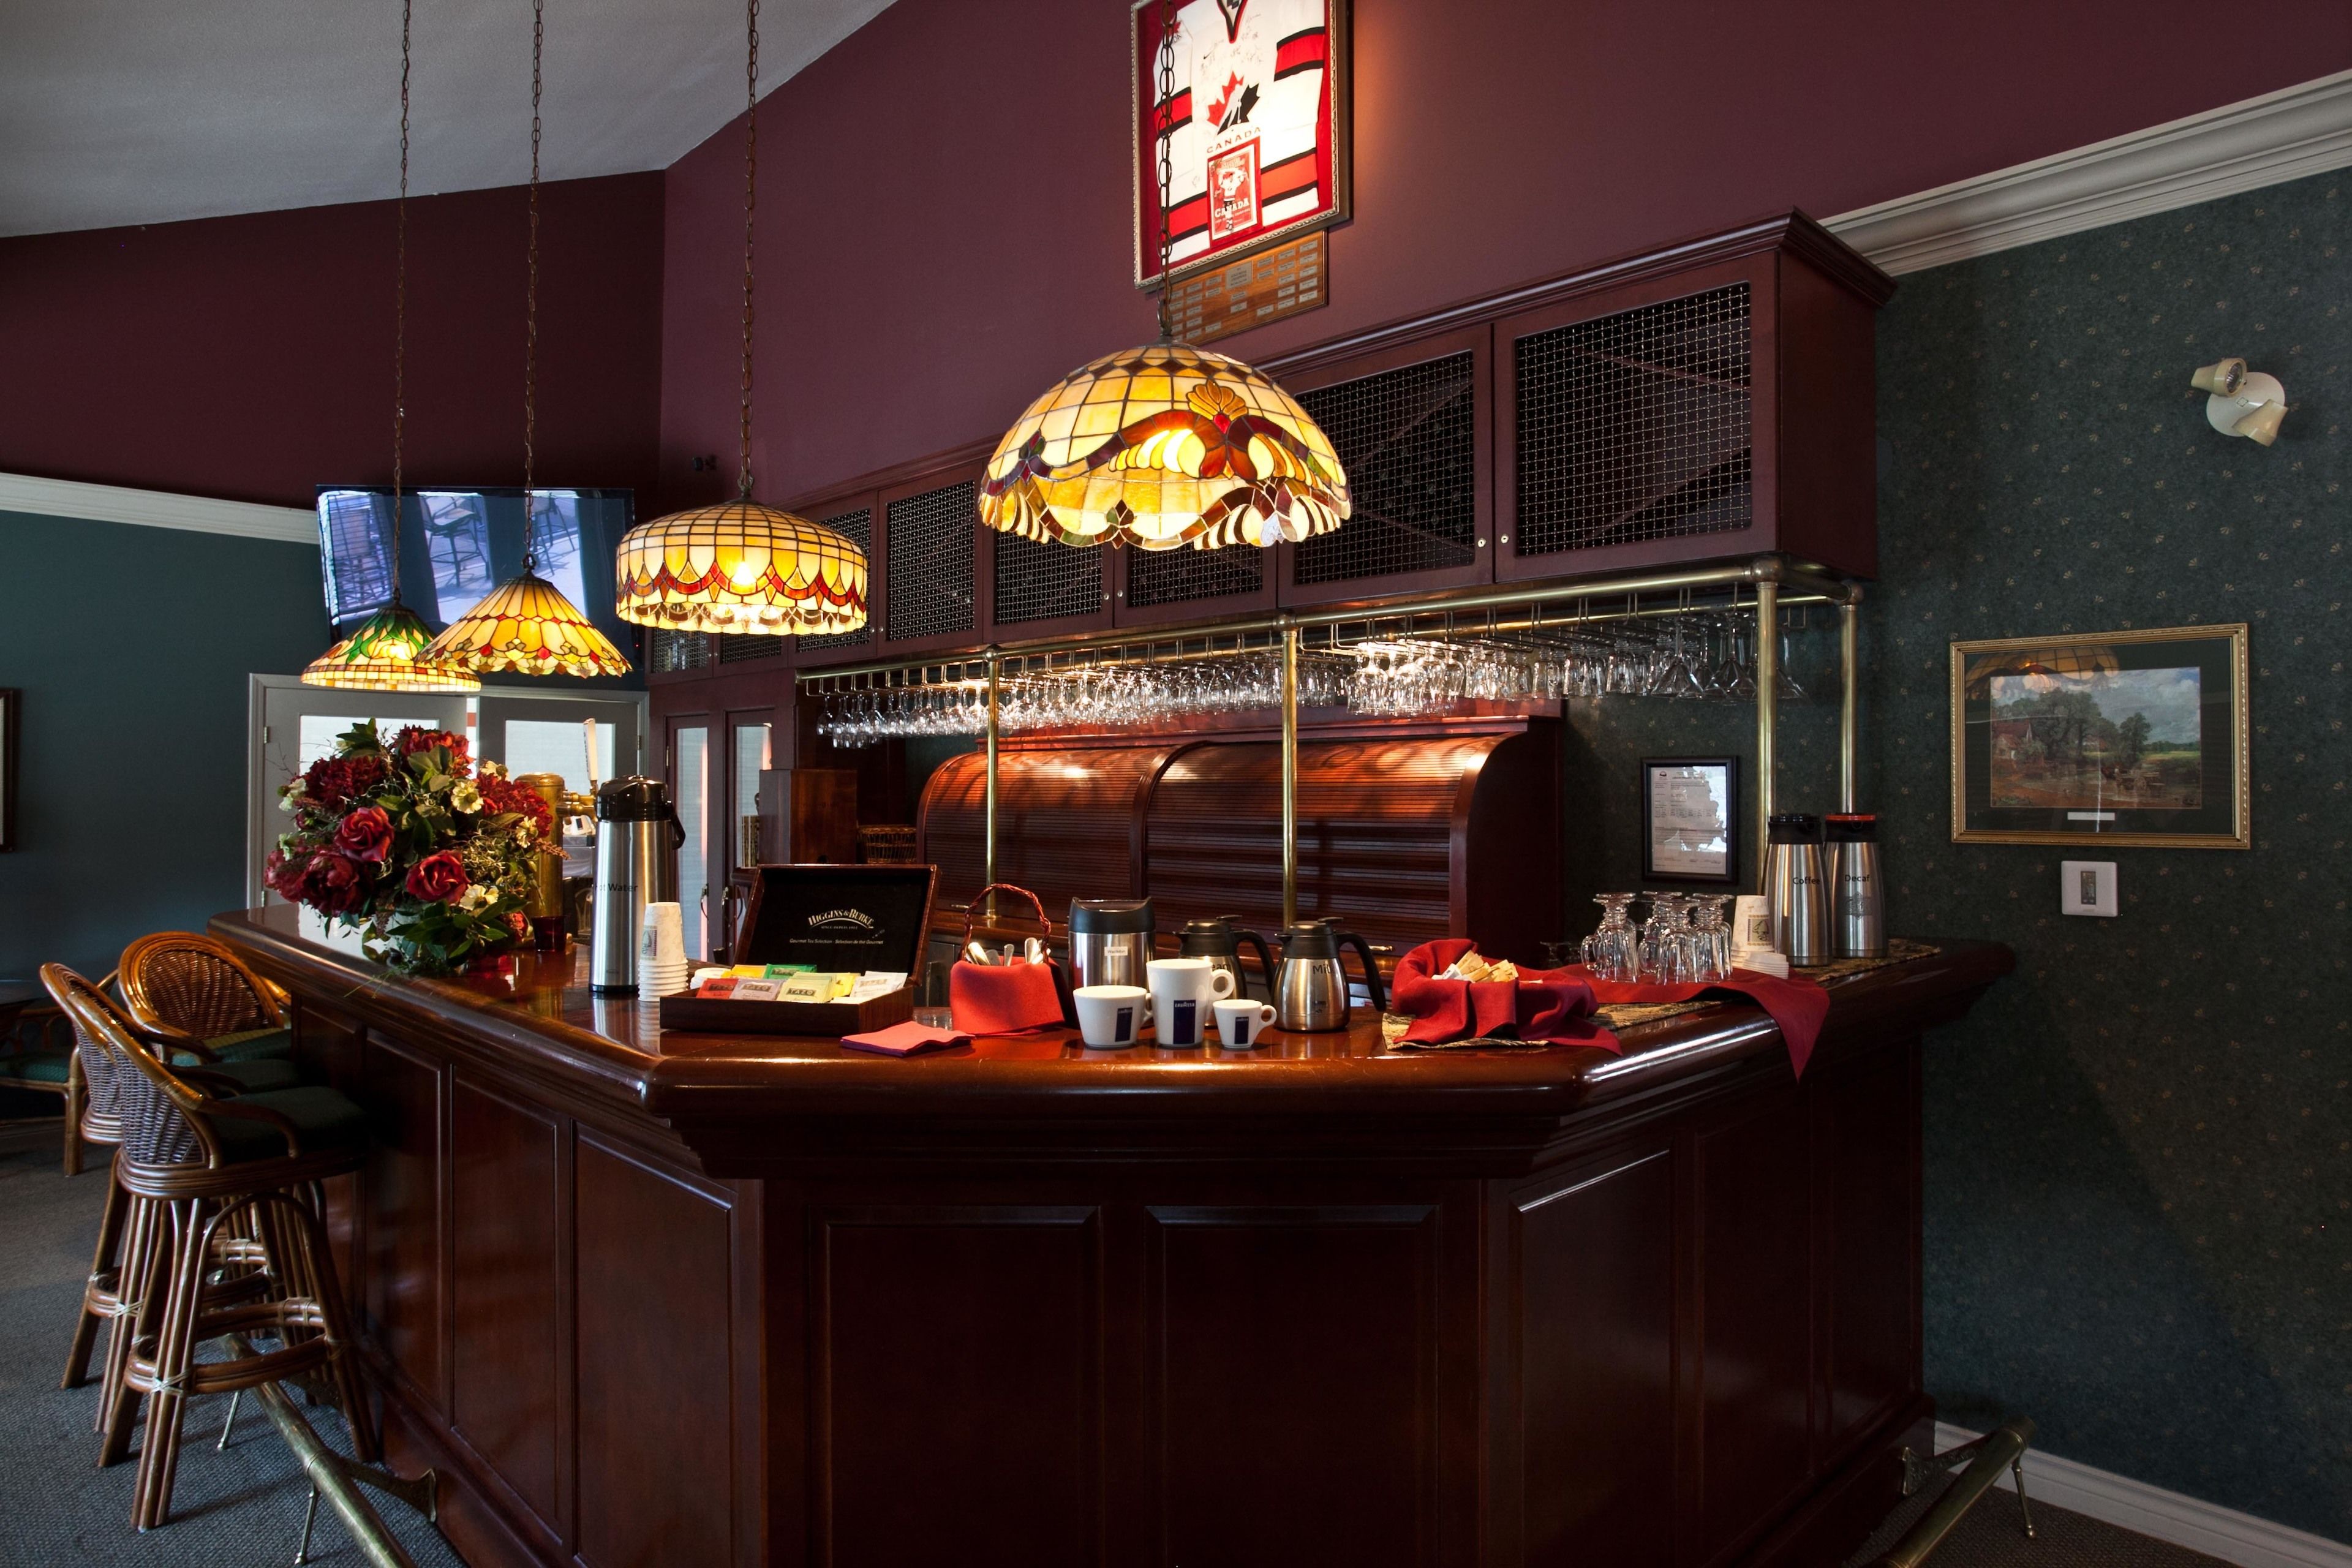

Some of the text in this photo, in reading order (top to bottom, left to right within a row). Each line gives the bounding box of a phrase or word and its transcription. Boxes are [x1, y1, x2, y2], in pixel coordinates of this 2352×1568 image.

[1207, 127, 1261, 153] CANADA
[1215, 197, 1250, 218] CANADA
[608, 883, 638, 892] Water
[809, 910, 843, 926] HIGGINS
[849, 908, 874, 925] BURKE
[1313, 963, 1332, 974] Mil
